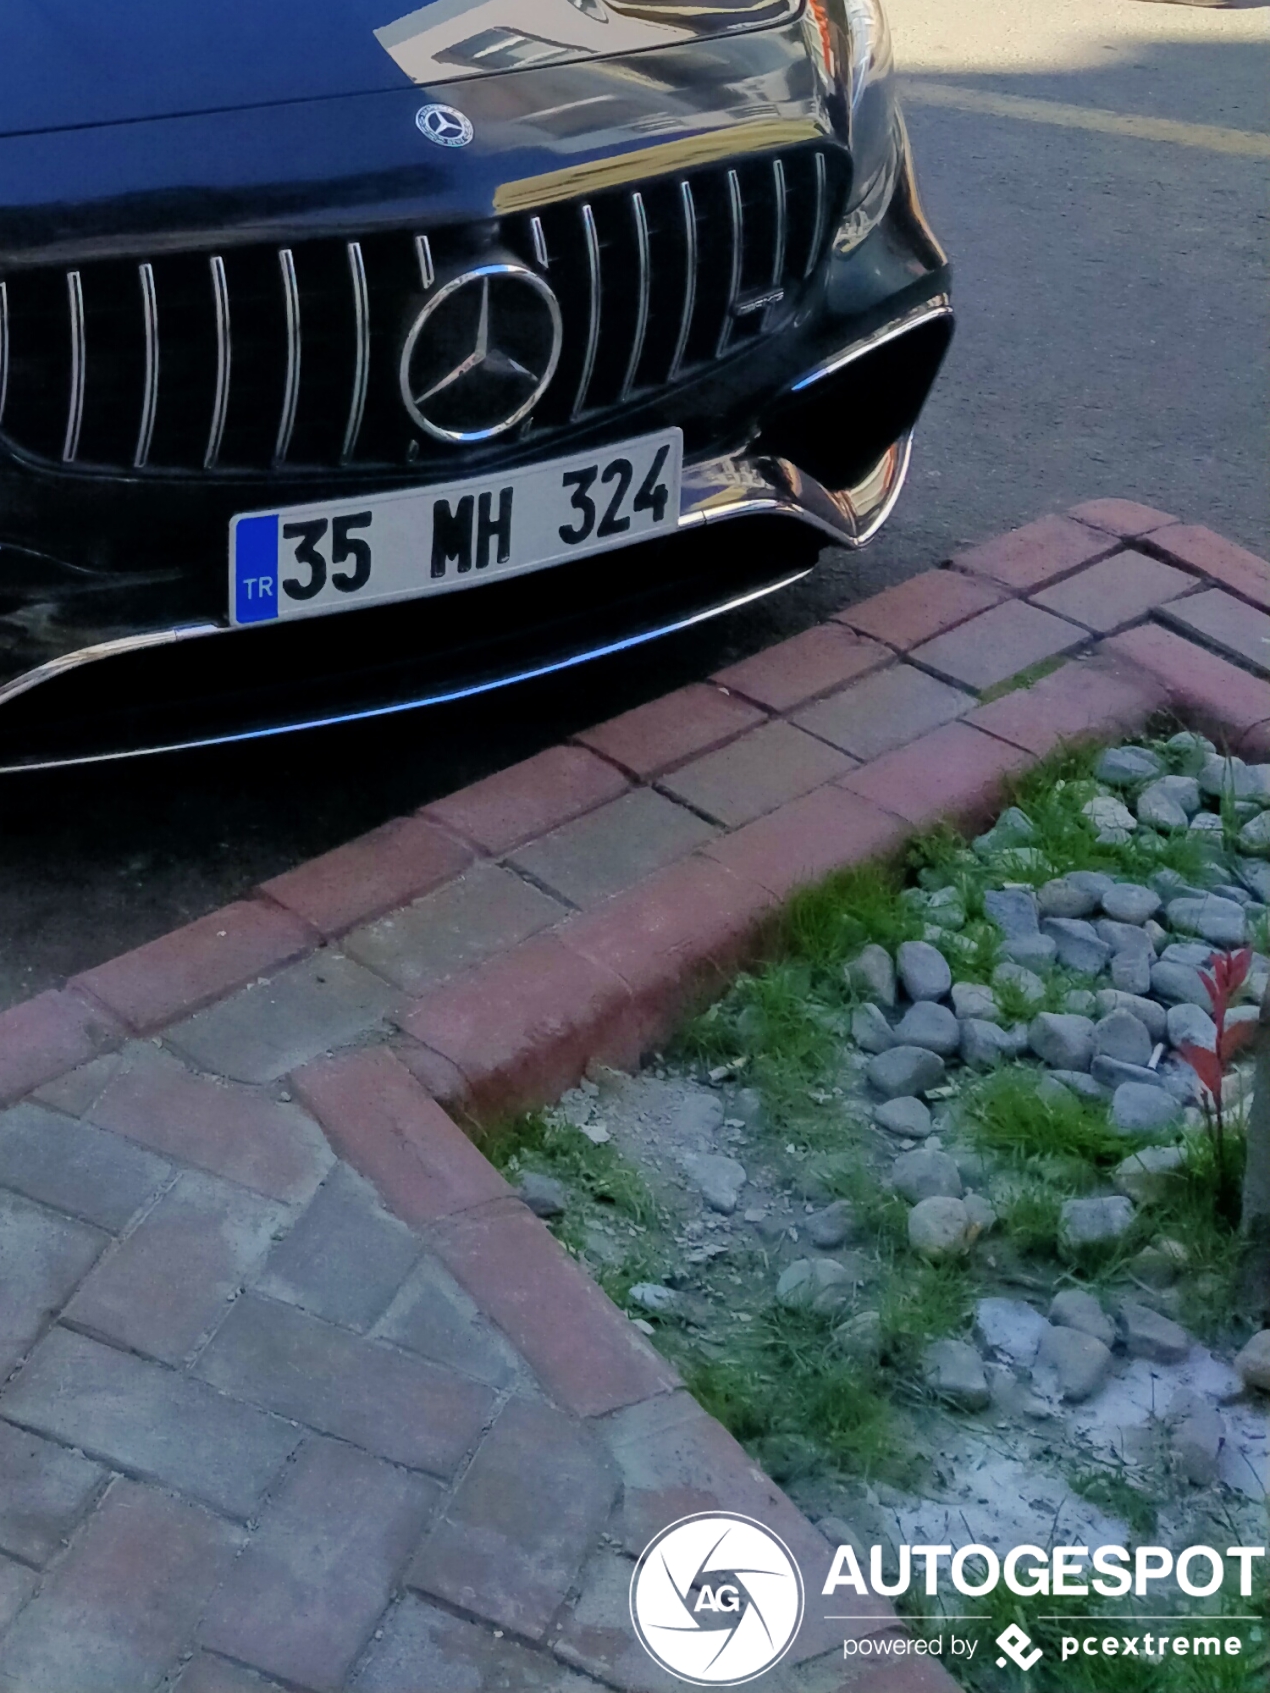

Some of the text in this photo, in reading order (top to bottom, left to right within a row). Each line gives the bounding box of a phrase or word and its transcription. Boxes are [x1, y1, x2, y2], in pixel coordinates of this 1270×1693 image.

[282, 444, 671, 601] 35 MH 324
[243, 576, 274, 600] TR
